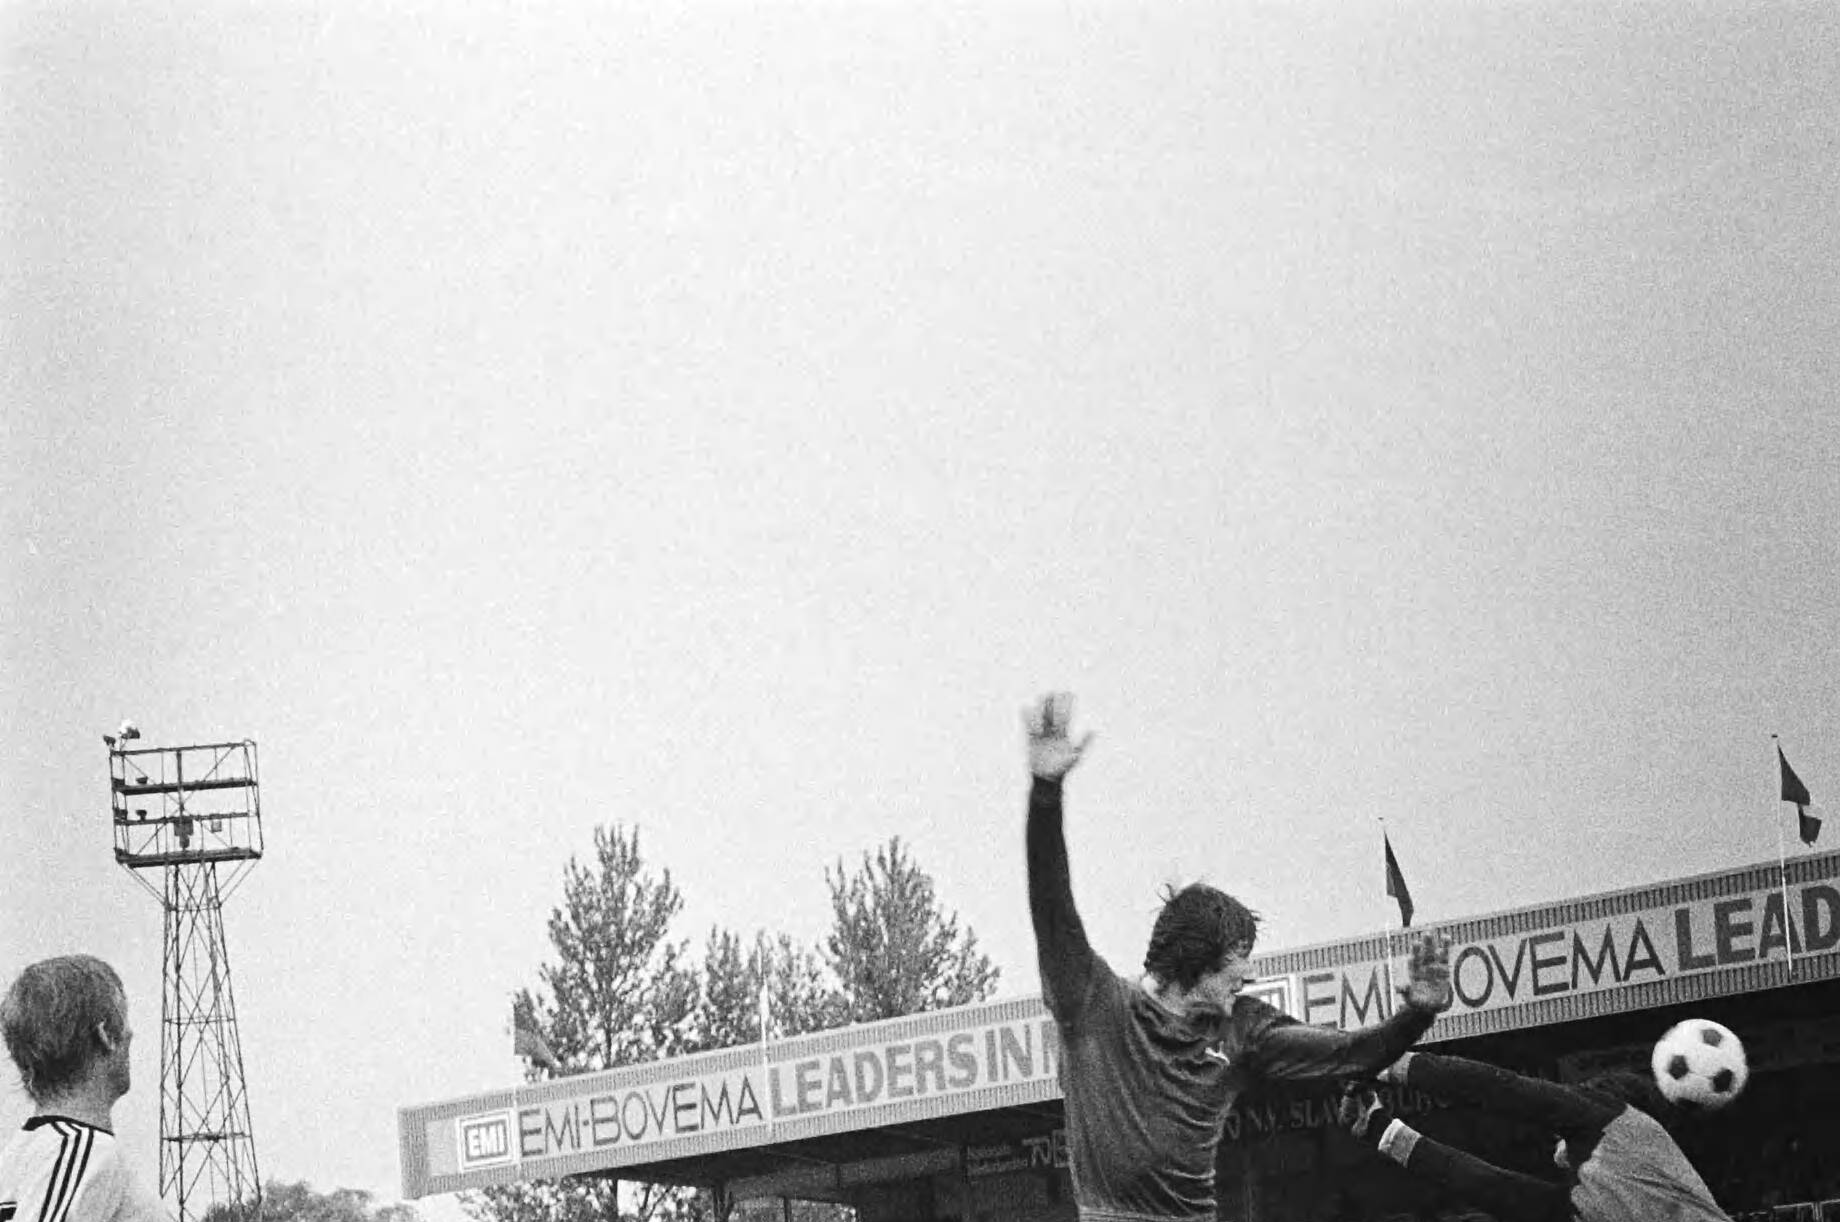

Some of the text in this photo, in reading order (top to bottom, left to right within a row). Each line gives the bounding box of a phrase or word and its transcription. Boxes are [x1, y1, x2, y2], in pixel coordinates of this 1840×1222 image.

[519, 1074, 763, 1157] EMI-BOVEMA
[769, 1033, 978, 1118] LEADERS
[986, 1024, 1033, 1082] IN
[467, 1122, 505, 1156] EMI
